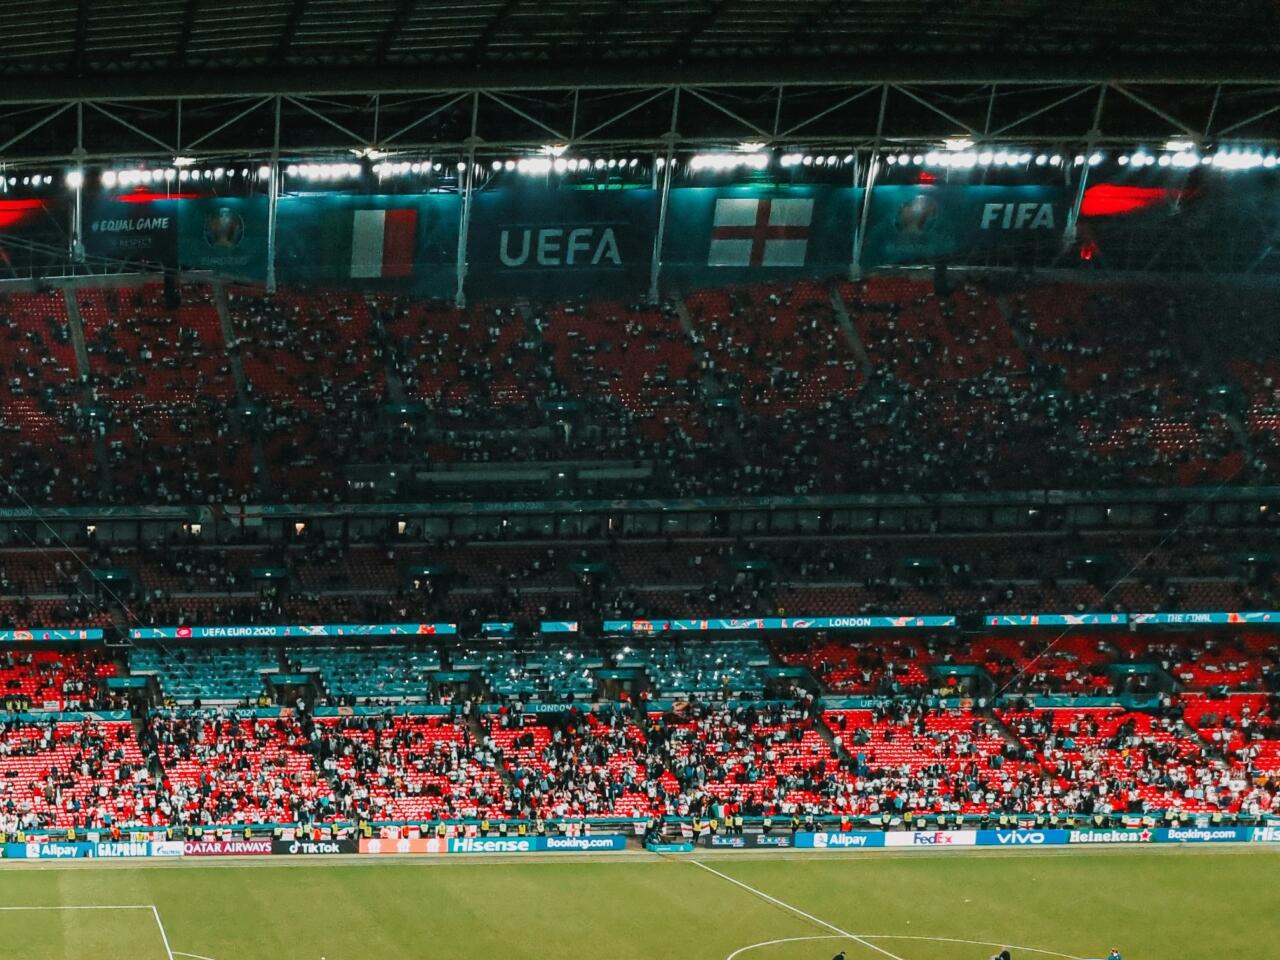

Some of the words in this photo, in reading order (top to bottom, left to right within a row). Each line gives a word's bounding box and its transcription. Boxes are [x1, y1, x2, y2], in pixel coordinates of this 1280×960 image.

[980, 203, 1055, 229] FIFA
[136, 217, 169, 231] GAME
[489, 227, 622, 267] UEFA
[829, 618, 871, 627] LONDON
[202, 627, 225, 636] UEFA
[227, 627, 252, 636] EURO
[253, 627, 276, 635] 2020
[830, 833, 867, 846] Alipay
[914, 832, 953, 844] FedEx
[1070, 830, 1138, 842] Heineken
[1168, 829, 1236, 840] Booking.com
[184, 842, 223, 854] QATAR
[225, 841, 272, 852] AIRWAYS
[302, 843, 340, 854] TikTok
[454, 838, 529, 852] Hisense
[547, 838, 613, 849] Booking.com
[42, 844, 78, 857] Alipay
[98, 844, 147, 856] GAZPROM
